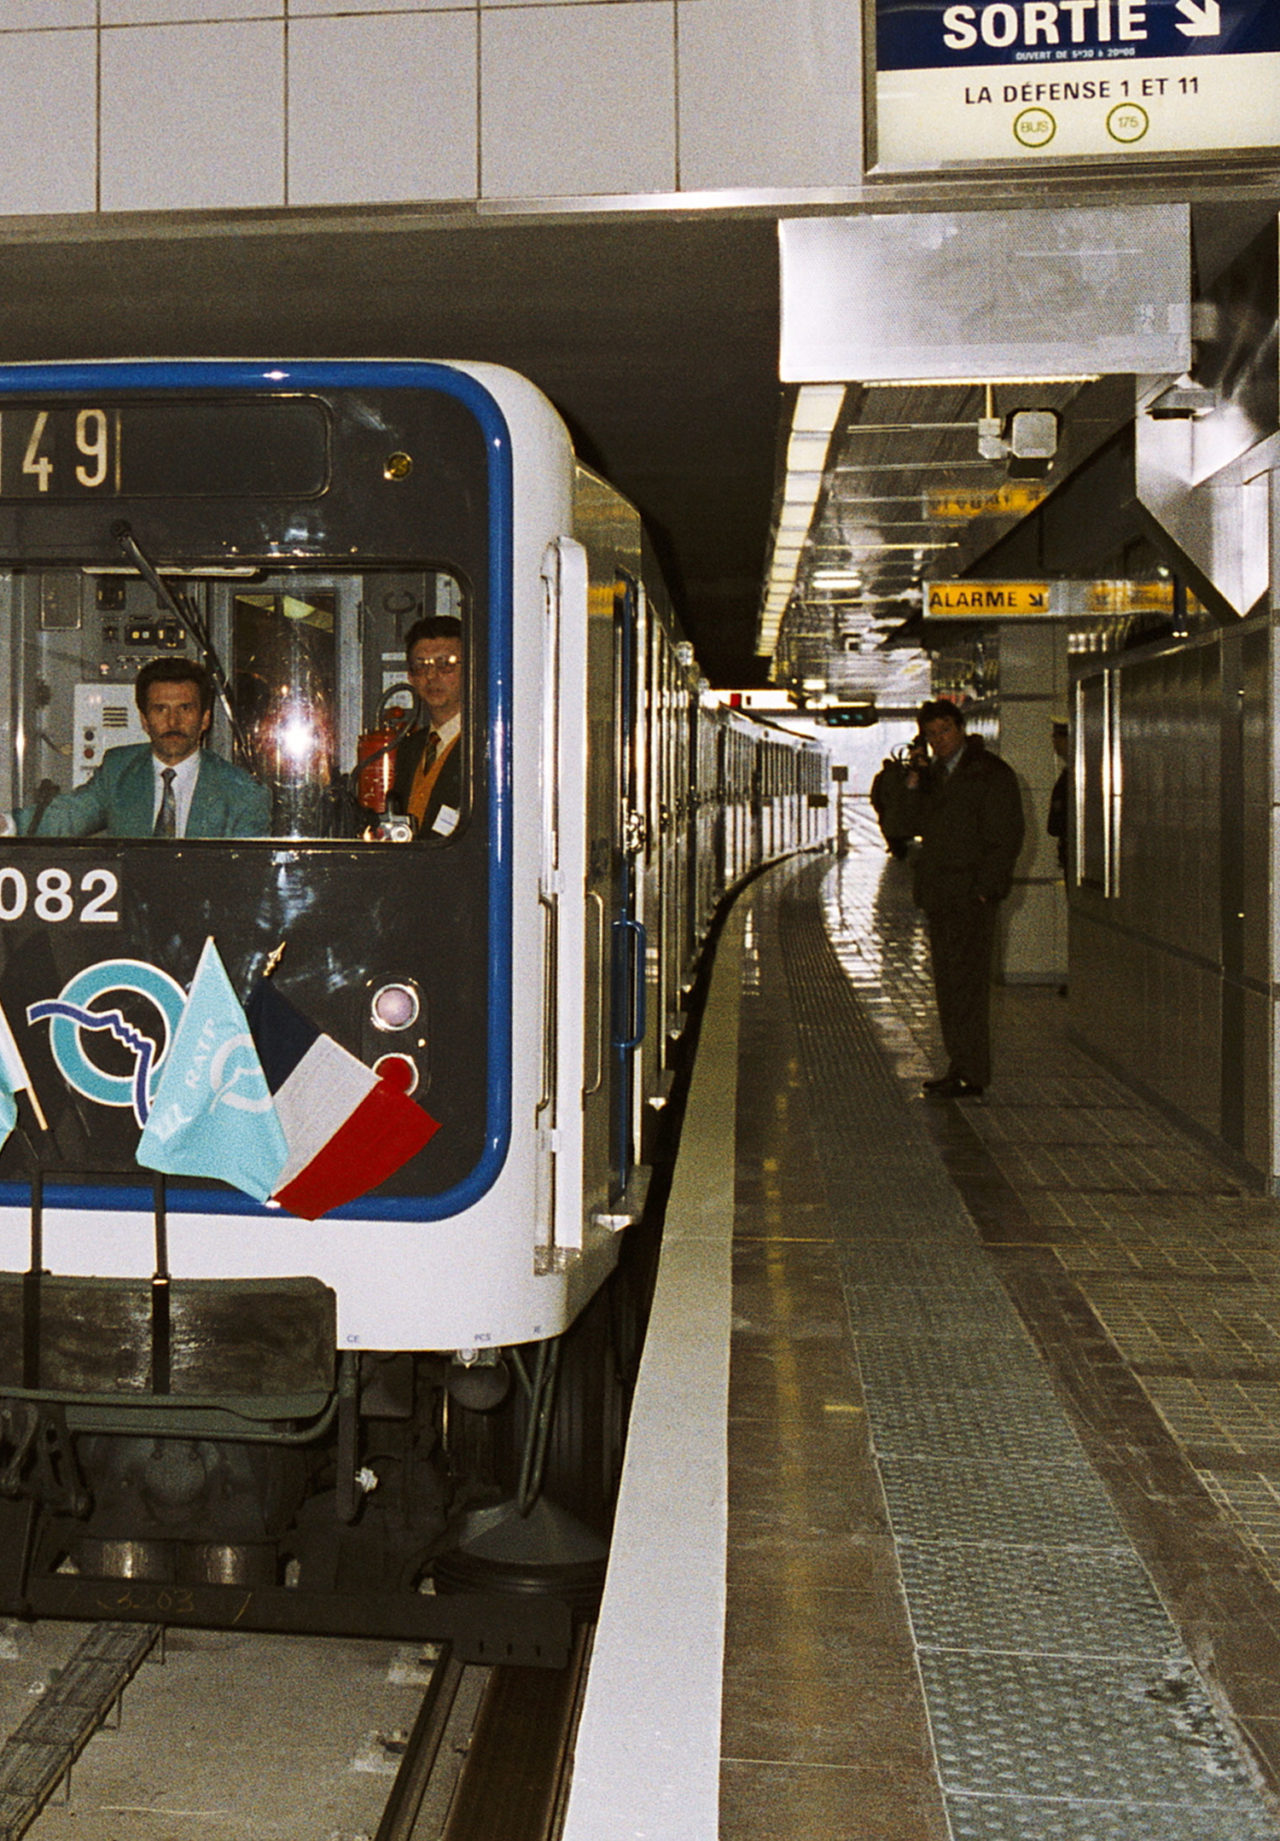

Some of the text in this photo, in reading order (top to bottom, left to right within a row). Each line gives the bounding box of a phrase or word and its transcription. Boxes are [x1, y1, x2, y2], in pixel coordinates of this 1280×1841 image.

[942, 0, 1148, 49] SORTIE
[1016, 50, 1051, 60] OUVERT
[1056, 50, 1067, 59] DE
[965, 77, 1199, 104] LA DÉFENSE 1 ET 11
[1020, 121, 1048, 133] BUS
[1118, 117, 1138, 128] 175
[929, 591, 1017, 608] ALARME
